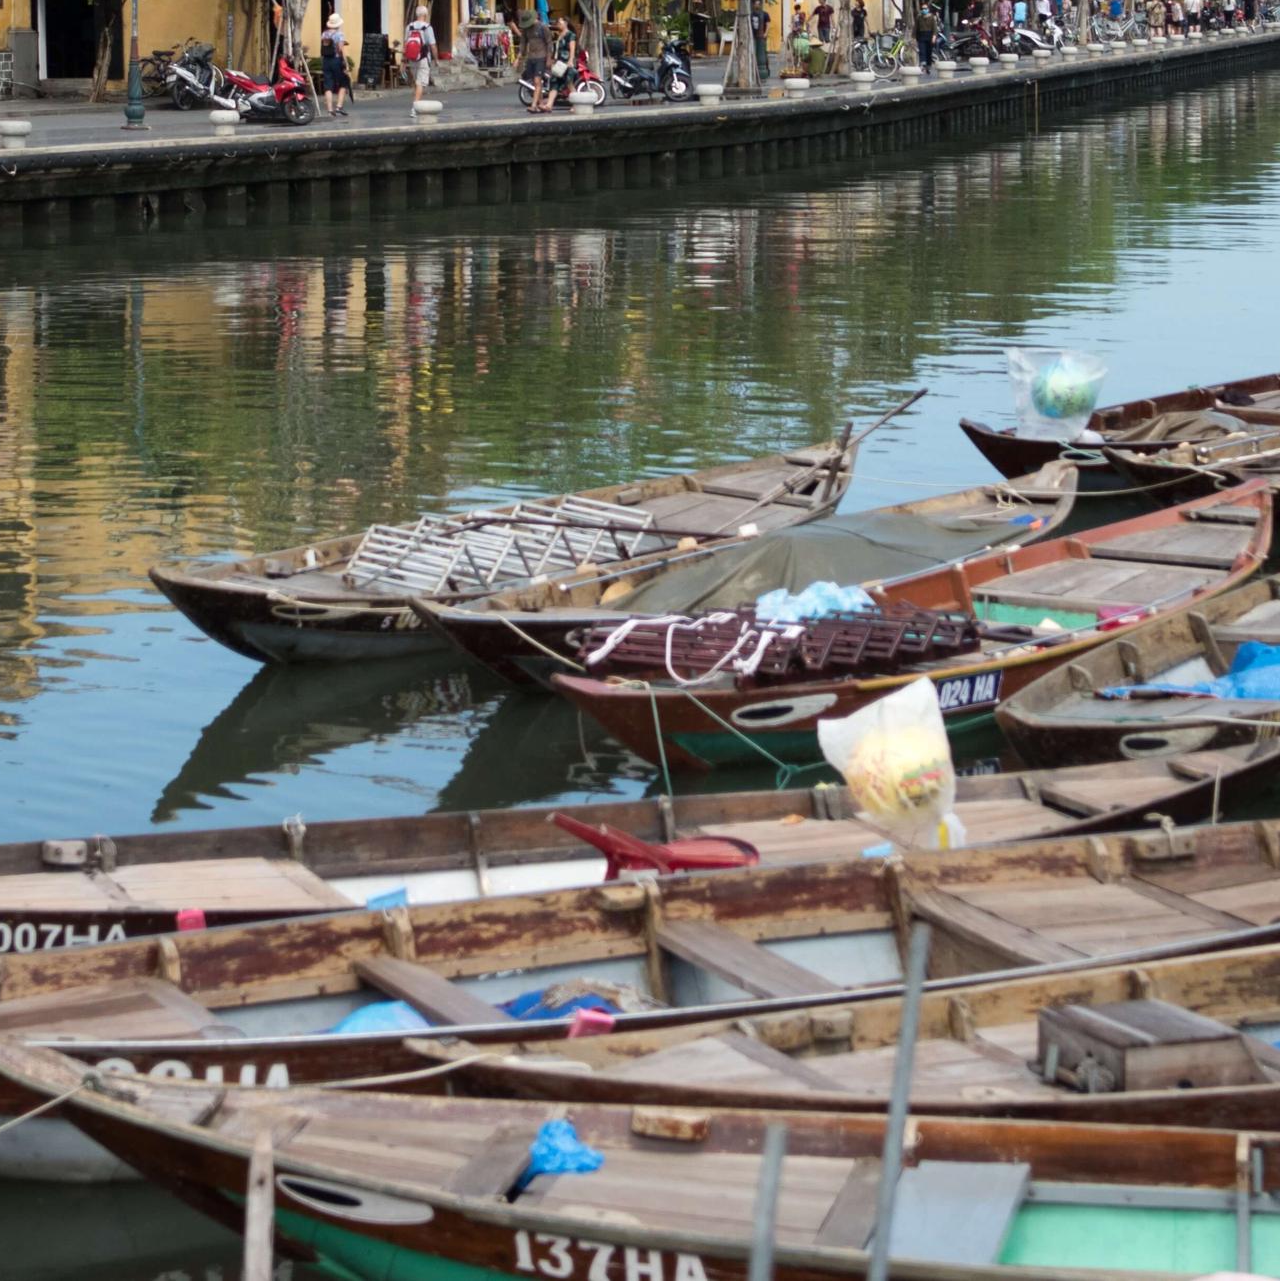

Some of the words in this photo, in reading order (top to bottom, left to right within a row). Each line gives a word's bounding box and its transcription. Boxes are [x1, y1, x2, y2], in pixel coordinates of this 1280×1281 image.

[940, 679, 971, 709] 024
[972, 673, 996, 703] HA
[514, 1230, 709, 1281] 137HA
